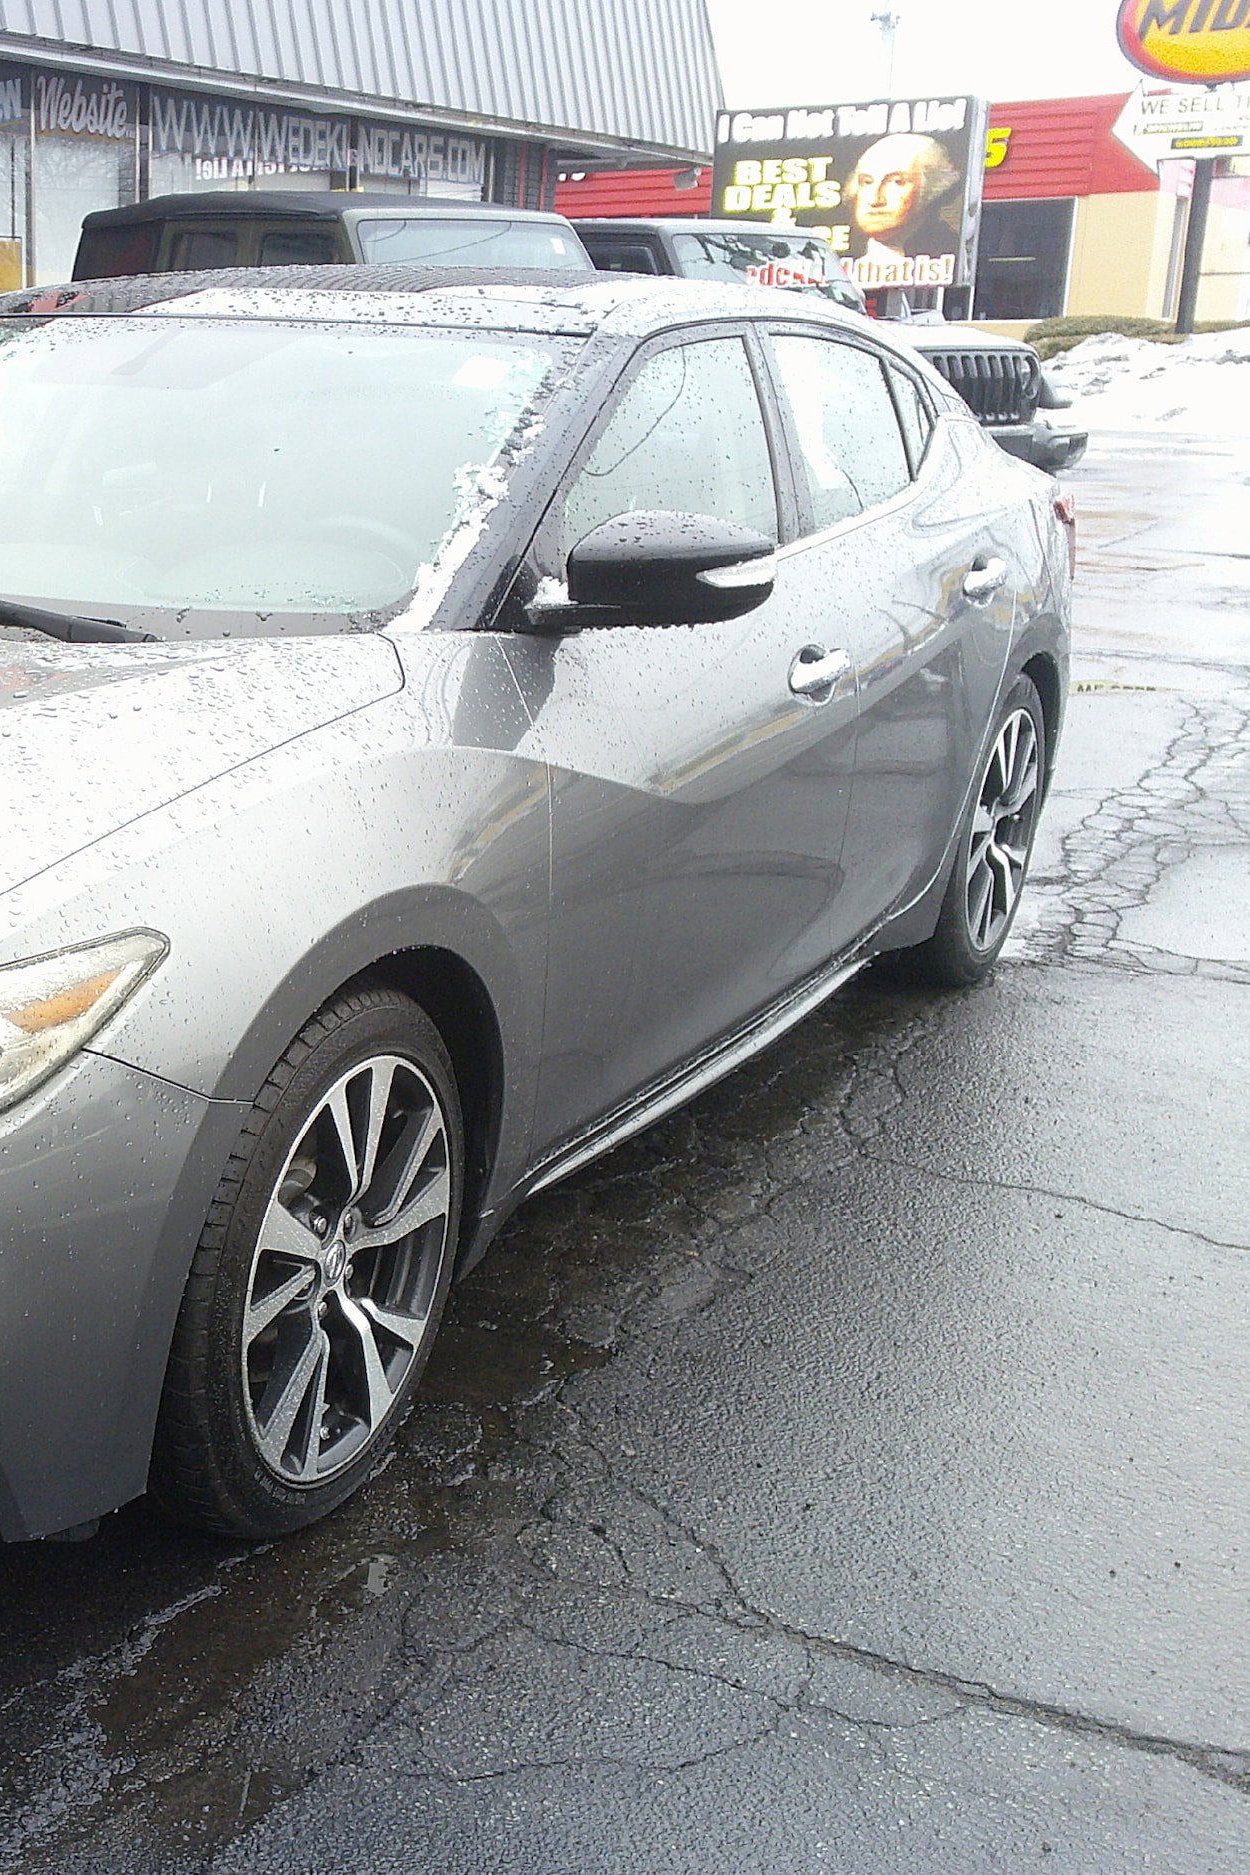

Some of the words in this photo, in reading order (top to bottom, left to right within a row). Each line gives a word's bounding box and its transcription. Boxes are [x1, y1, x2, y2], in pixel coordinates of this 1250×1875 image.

[888, 101, 912, 134] A
[1141, 99, 1169, 115] WE
[1177, 96, 1224, 113] SELL
[735, 157, 834, 185] BEST
[724, 181, 841, 211] DEALS
[856, 261, 908, 282] that
[918, 257, 951, 281] is!
